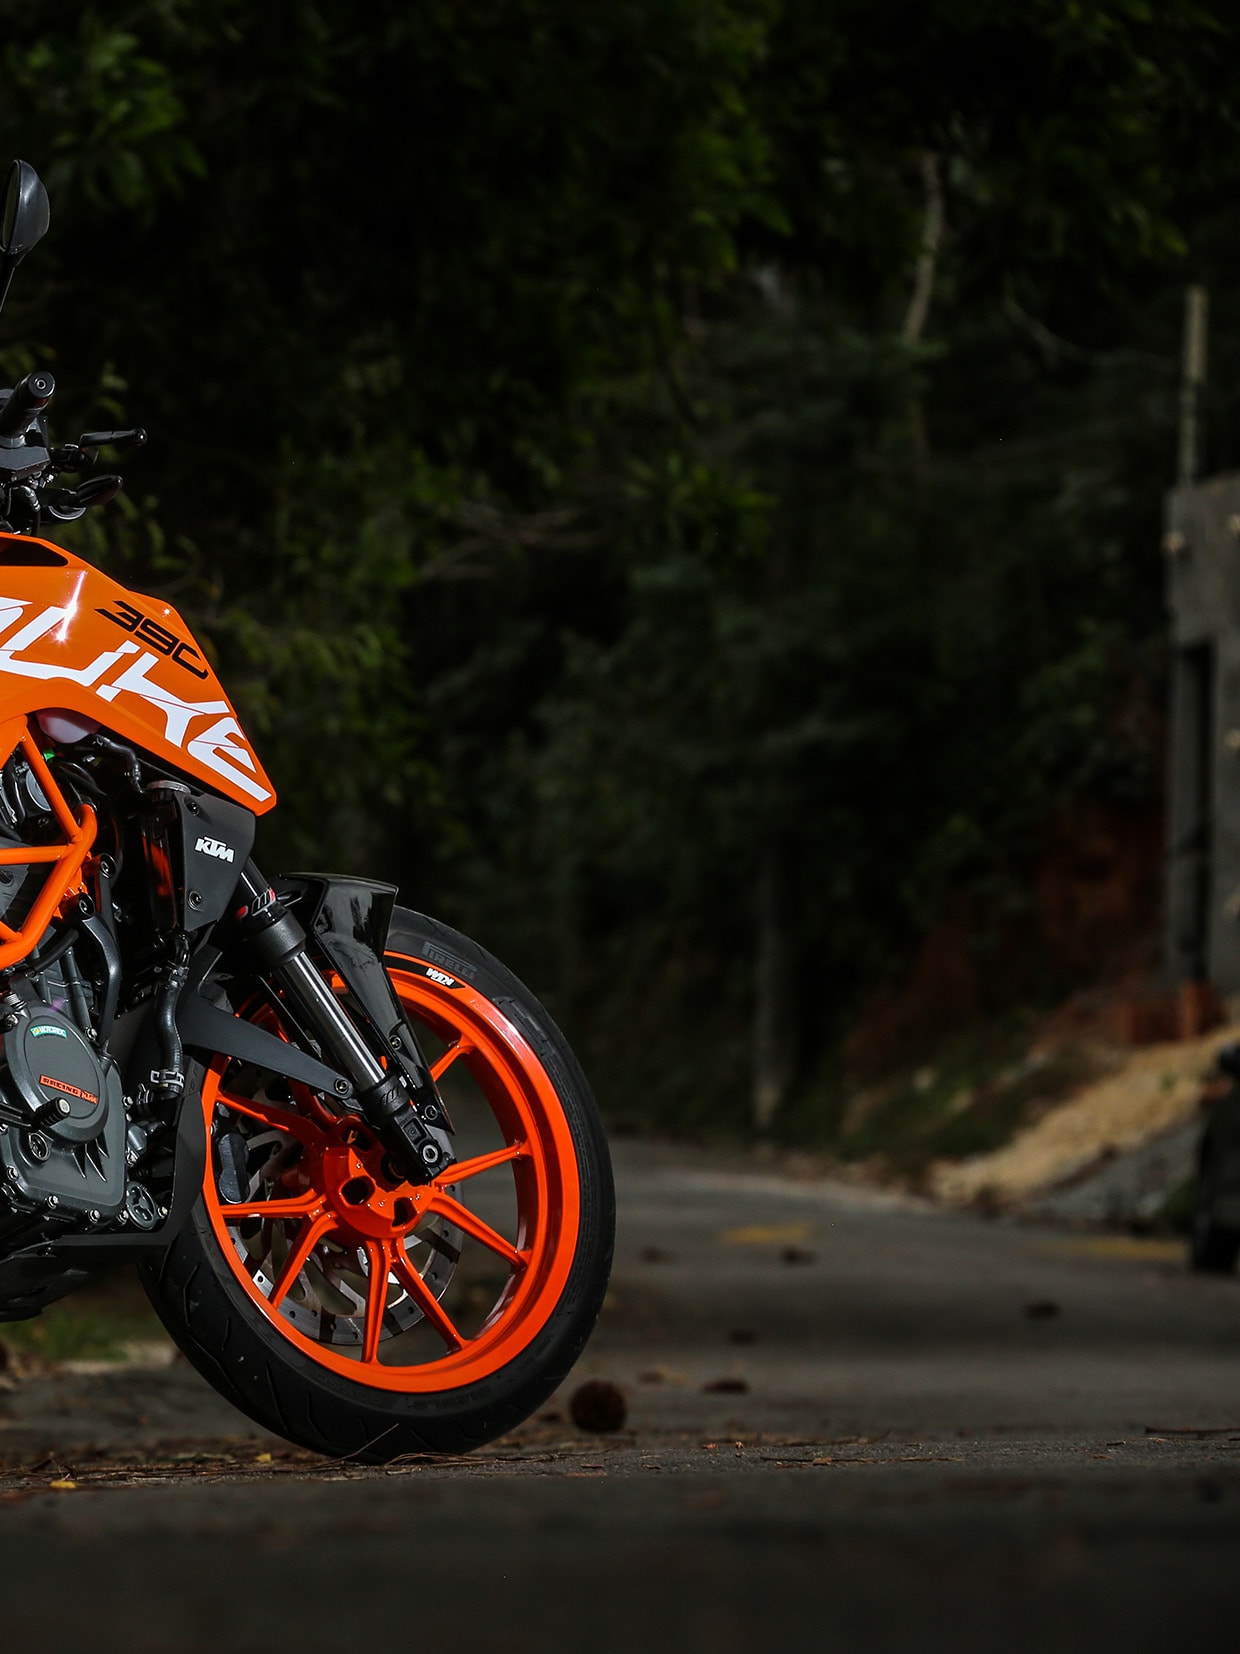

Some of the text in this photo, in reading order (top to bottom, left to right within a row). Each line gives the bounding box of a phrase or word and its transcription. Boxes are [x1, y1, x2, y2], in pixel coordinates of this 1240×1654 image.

[95, 600, 209, 680] 390
[194, 836, 235, 864] KTM
[421, 941, 478, 981] PIRELLI
[425, 967, 456, 987] KTM
[42, 1077, 79, 1096] RACING
